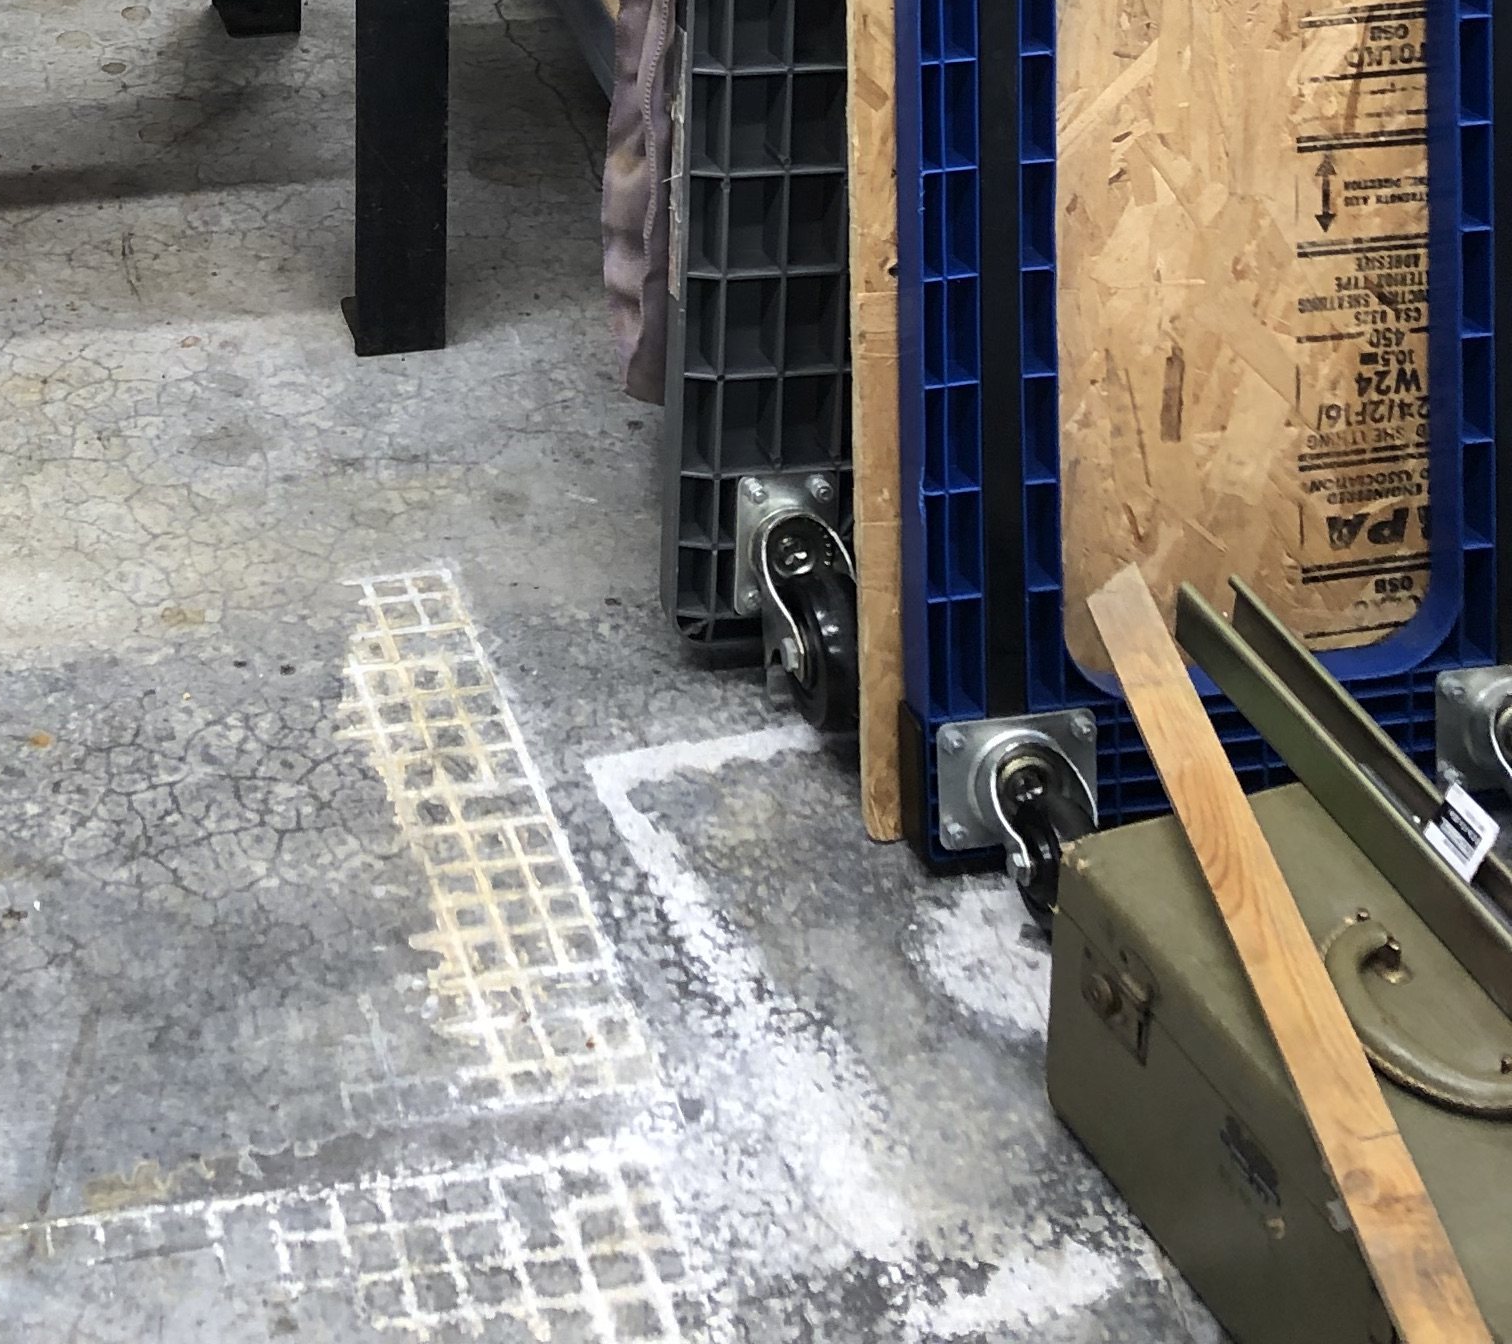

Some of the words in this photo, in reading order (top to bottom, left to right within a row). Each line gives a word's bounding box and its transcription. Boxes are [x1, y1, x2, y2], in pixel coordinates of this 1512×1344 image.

[1369, 24, 1409, 41] OSB
[1356, 253, 1421, 271] ADHESIVE
[1335, 276, 1368, 292] TYPE
[1394, 306, 1422, 323] CSA
[1354, 367, 1422, 397] W24
[1374, 576, 1413, 594] OSB
